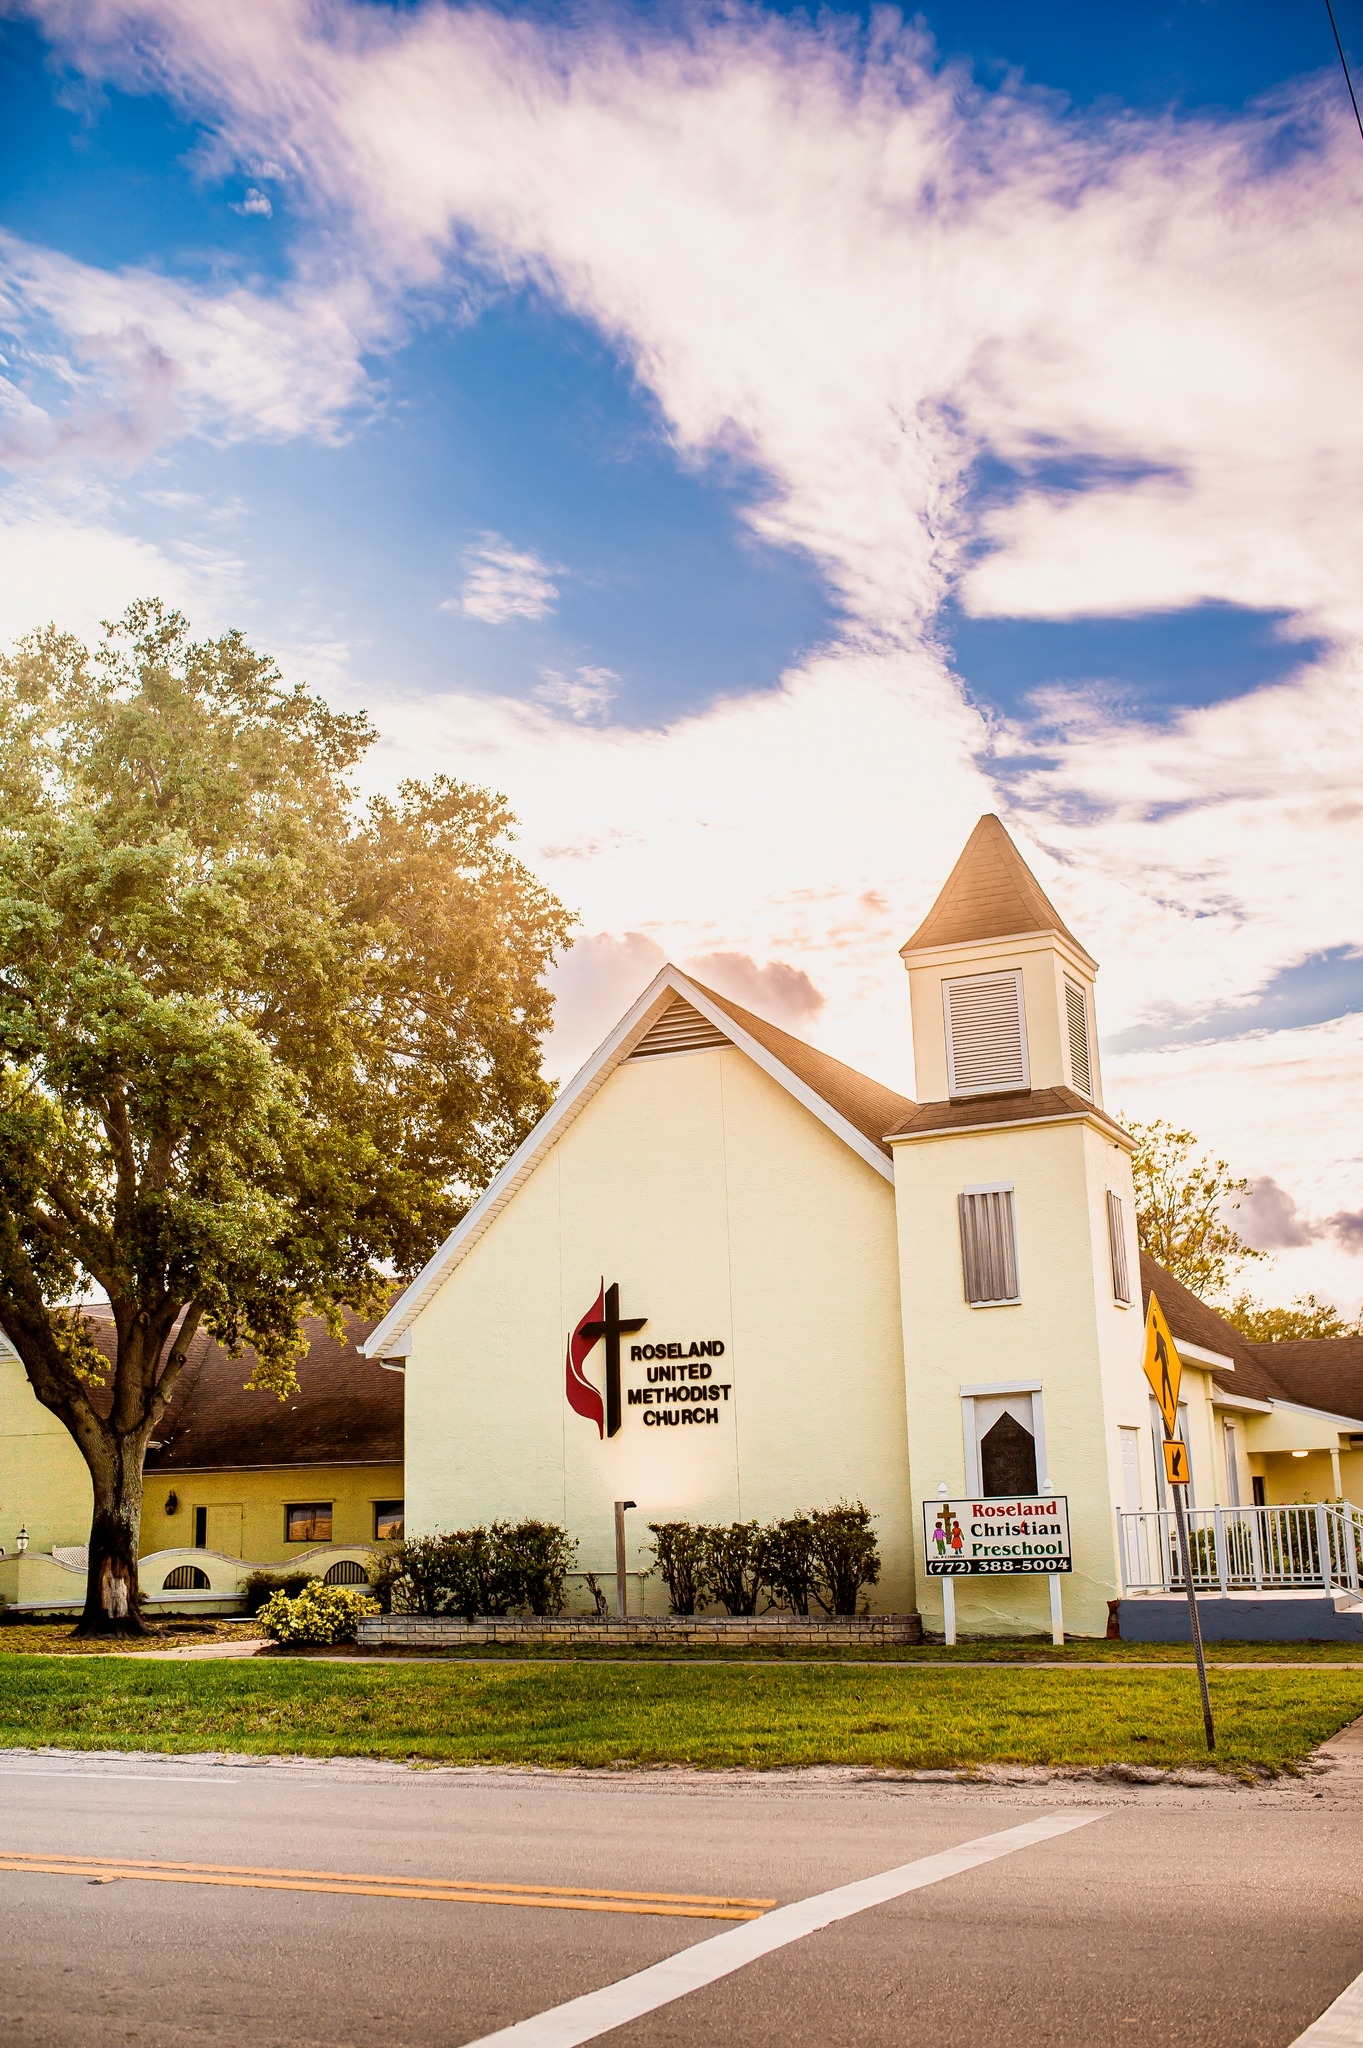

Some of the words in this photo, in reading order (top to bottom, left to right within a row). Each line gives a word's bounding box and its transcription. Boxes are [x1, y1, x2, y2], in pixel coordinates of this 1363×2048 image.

[631, 1340, 725, 1361] ROSELAND
[647, 1363, 712, 1383] UNITED
[628, 1385, 731, 1404] METHODIST
[643, 1407, 718, 1426] CHURCH
[972, 1501, 1057, 1517] Roseland
[971, 1521, 1061, 1537] Christian
[972, 1540, 1063, 1556] Preschool
[928, 1561, 972, 1574] (772)
[978, 1558, 1069, 1572] 388-5004
